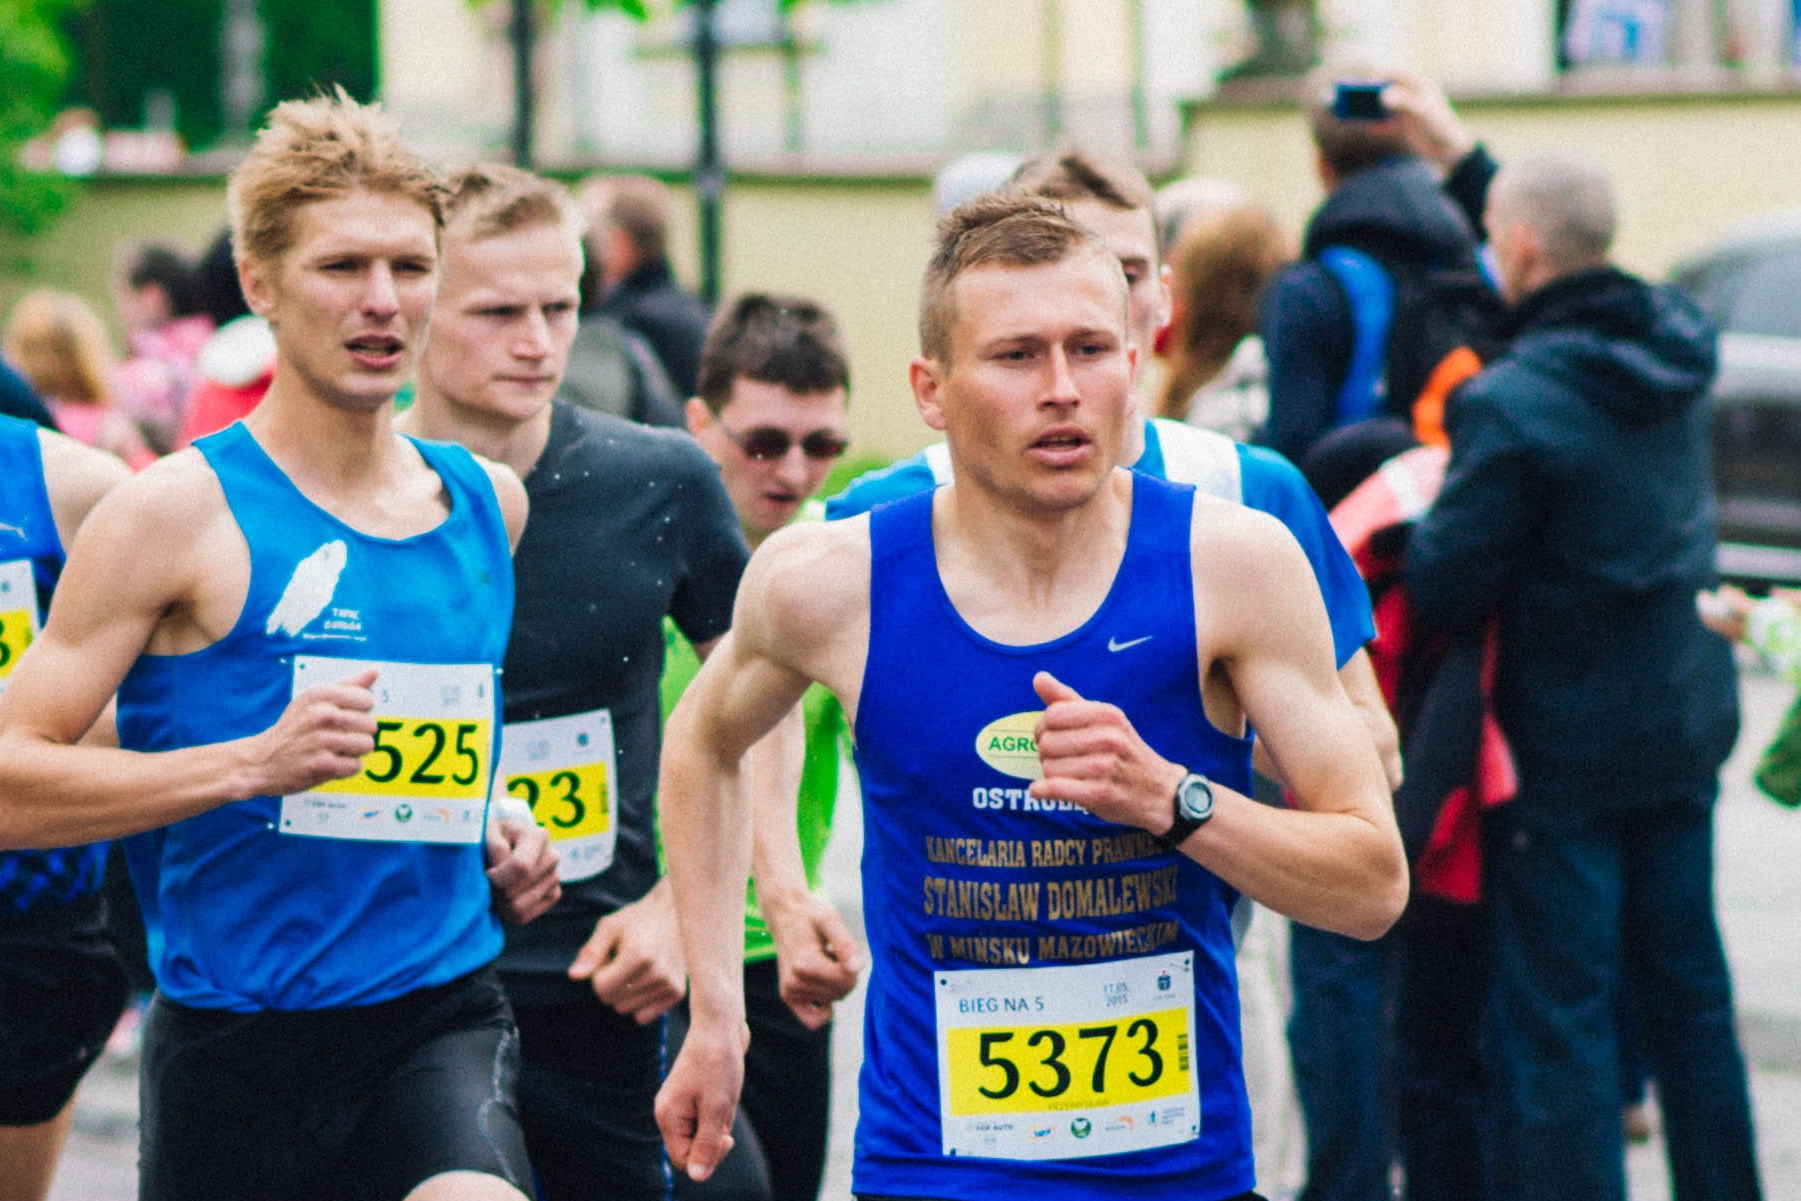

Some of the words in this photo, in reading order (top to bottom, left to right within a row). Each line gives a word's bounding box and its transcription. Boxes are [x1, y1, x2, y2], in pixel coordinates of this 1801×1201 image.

[365, 721, 479, 786] 525
[507, 771, 586, 829] 23
[926, 836, 1026, 867] KANCELARIA
[1031, 840, 1086, 867] RADCY
[1092, 832, 1162, 865] PRAWN
[924, 876, 1040, 922] STANISŁAW
[1047, 865, 1179, 921] DOMALEWSKI
[926, 934, 944, 960] W
[1038, 920, 1179, 961] MAZOWIECKIM
[959, 997, 999, 1013] BIEG
[1004, 998, 1029, 1012] NA
[1035, 996, 1045, 1011] 5
[978, 1018, 1164, 1099] 5373
